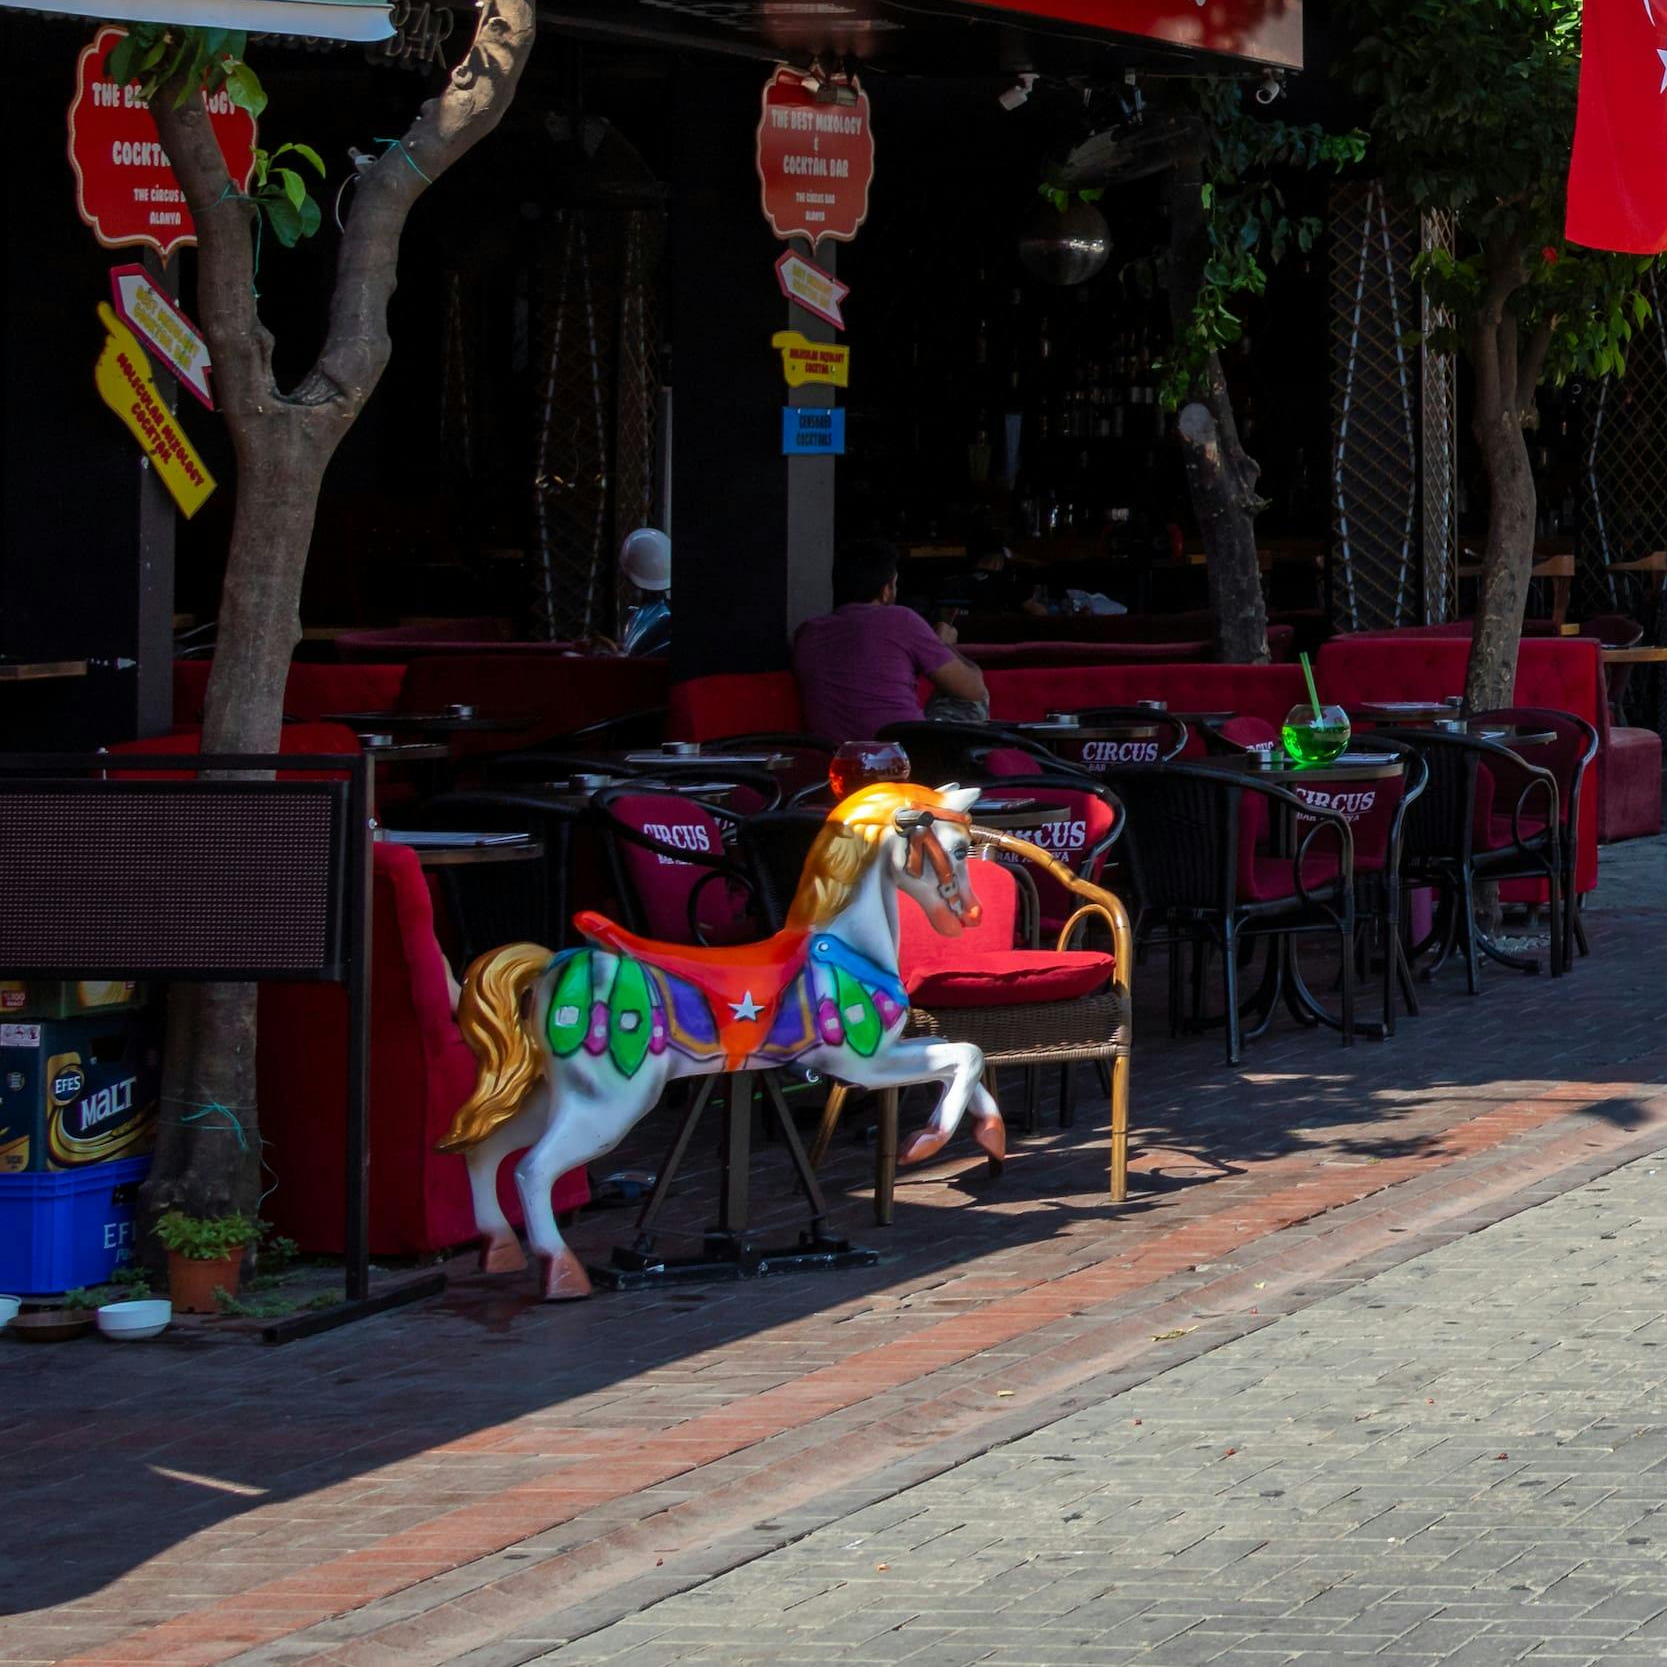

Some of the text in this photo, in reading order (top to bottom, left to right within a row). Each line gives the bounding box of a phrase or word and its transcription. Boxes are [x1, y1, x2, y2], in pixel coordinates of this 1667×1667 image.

[772, 109, 862, 136] THE BEST MIXOLOGY
[1081, 741, 1159, 763] CIRCUS
[54, 1074, 82, 1095] EFES
